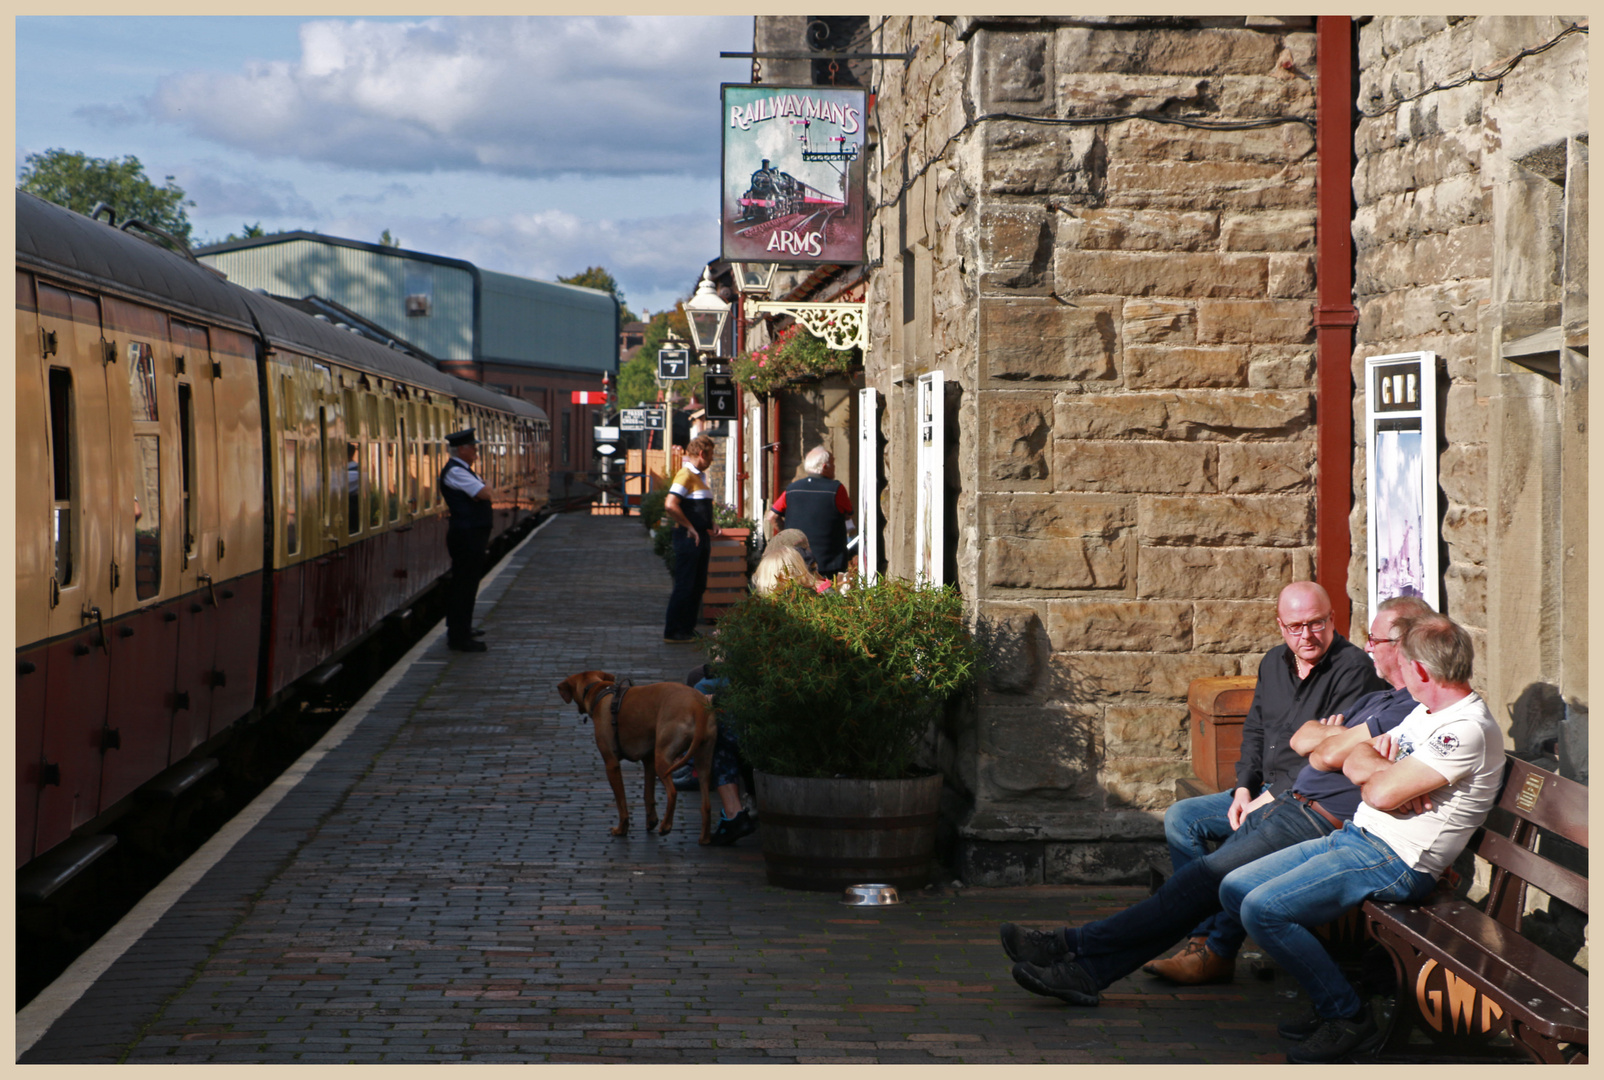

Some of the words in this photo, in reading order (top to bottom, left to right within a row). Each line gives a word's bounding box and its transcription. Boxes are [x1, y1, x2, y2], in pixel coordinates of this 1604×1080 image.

[731, 94, 859, 134] RAILWAYMAN'S
[766, 230, 822, 257] ARMS
[670, 364, 678, 374] 7
[1382, 374, 1416, 404] GWR
[717, 396, 725, 410] 6
